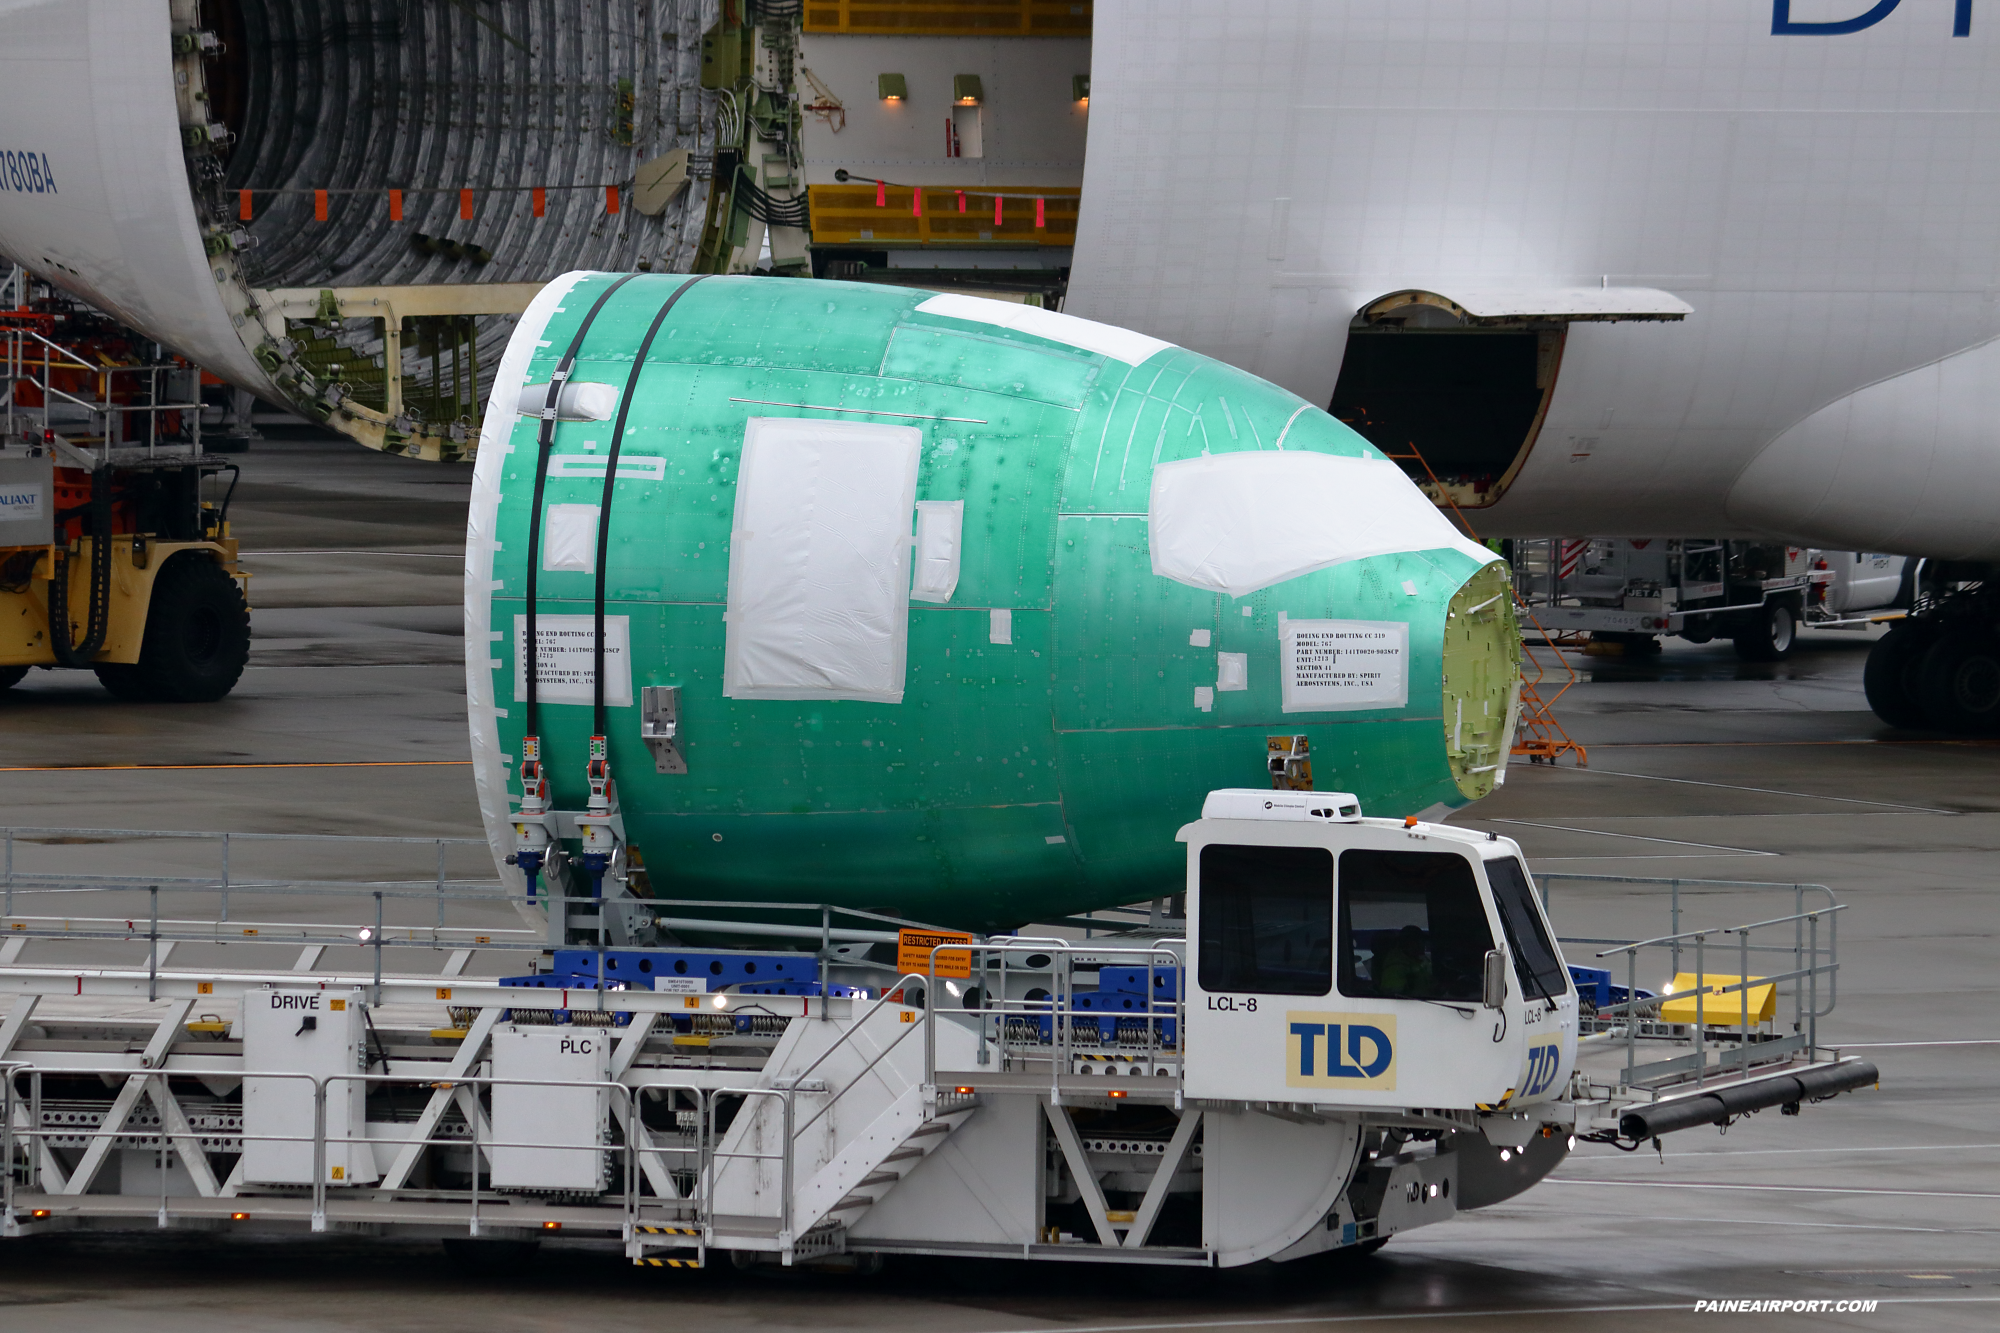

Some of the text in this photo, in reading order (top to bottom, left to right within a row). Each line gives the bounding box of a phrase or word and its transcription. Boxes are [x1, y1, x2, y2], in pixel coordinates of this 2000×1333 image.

[0, 150, 58, 194] 780BA
[903, 935, 941, 946] RESTRICTED
[202, 983, 208, 994] 6
[440, 989, 446, 999] 5
[271, 995, 319, 1010] DRIVE
[689, 998, 694, 1008] 4
[1208, 996, 1258, 1012] LCL-8
[904, 1012, 910, 1022] 3
[1524, 1008, 1541, 1025] LCL-8
[560, 1040, 592, 1054] PLC
[1290, 1022, 1393, 1078] TLD
[1519, 1044, 1560, 1098] TLD
